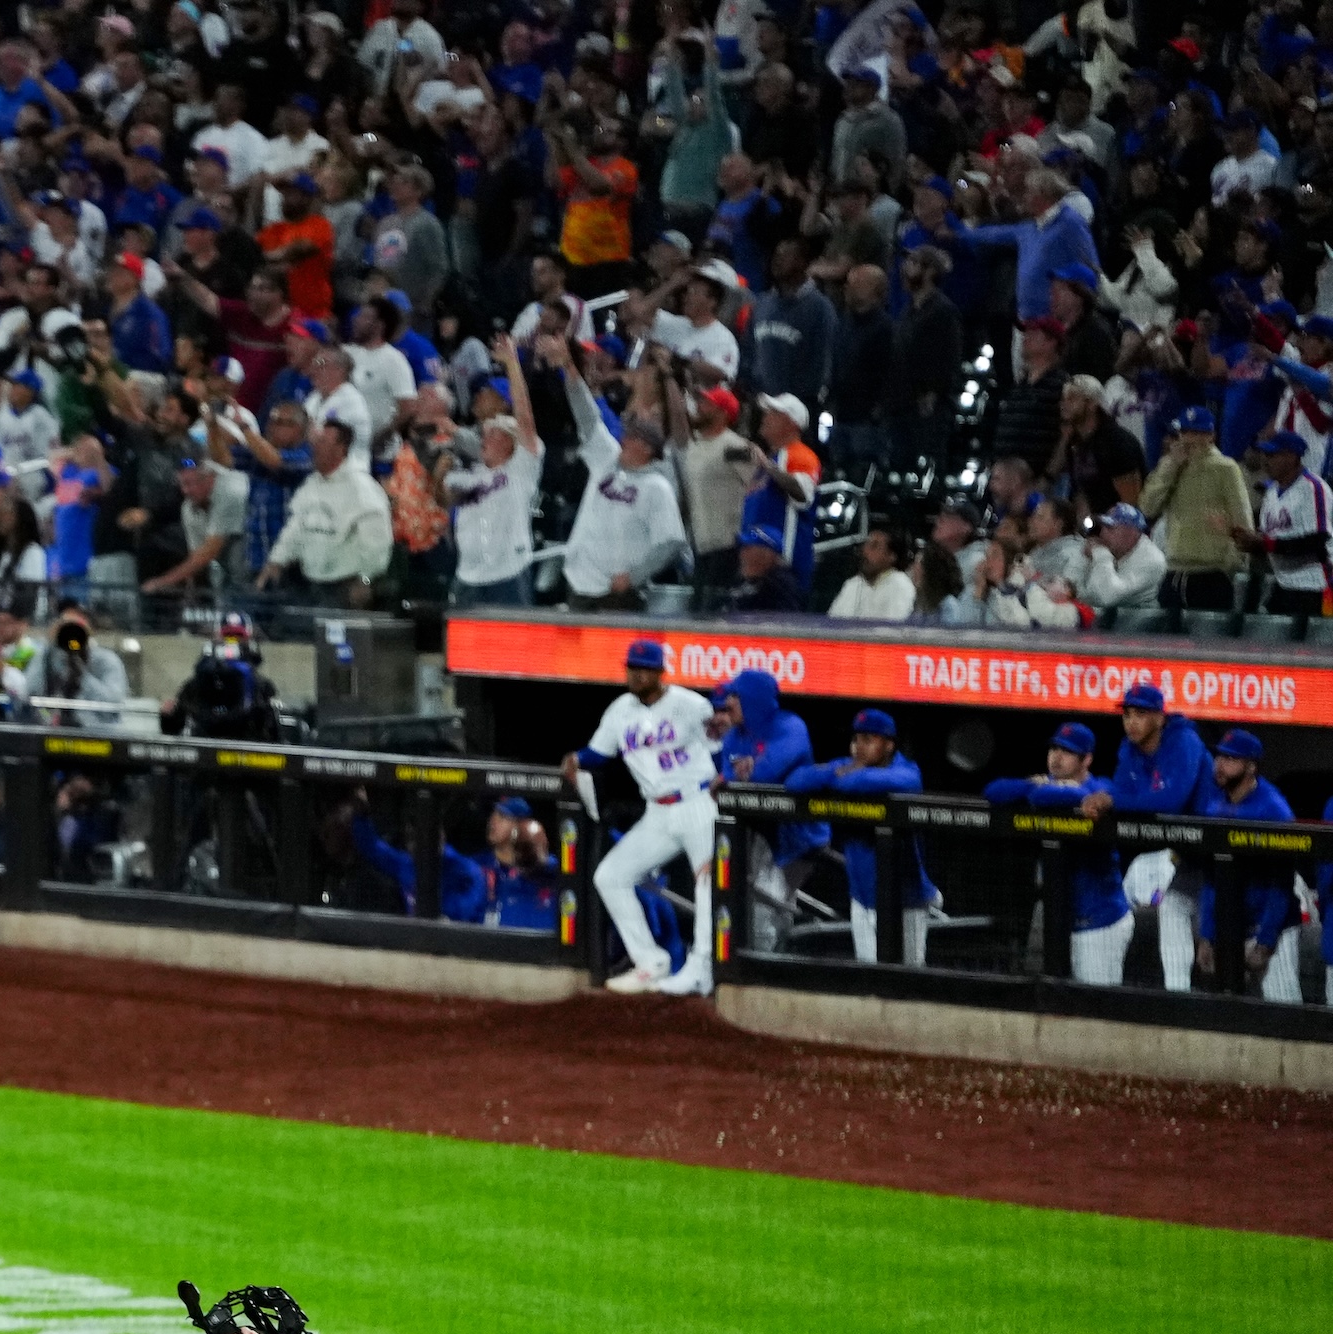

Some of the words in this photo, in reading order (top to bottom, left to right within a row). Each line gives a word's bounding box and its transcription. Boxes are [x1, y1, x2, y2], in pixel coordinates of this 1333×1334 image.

[681, 643, 805, 684] moomoo
[905, 655, 981, 690] TRADE
[987, 659, 1049, 701] ETFs,
[1182, 670, 1296, 710] OPTIONS
